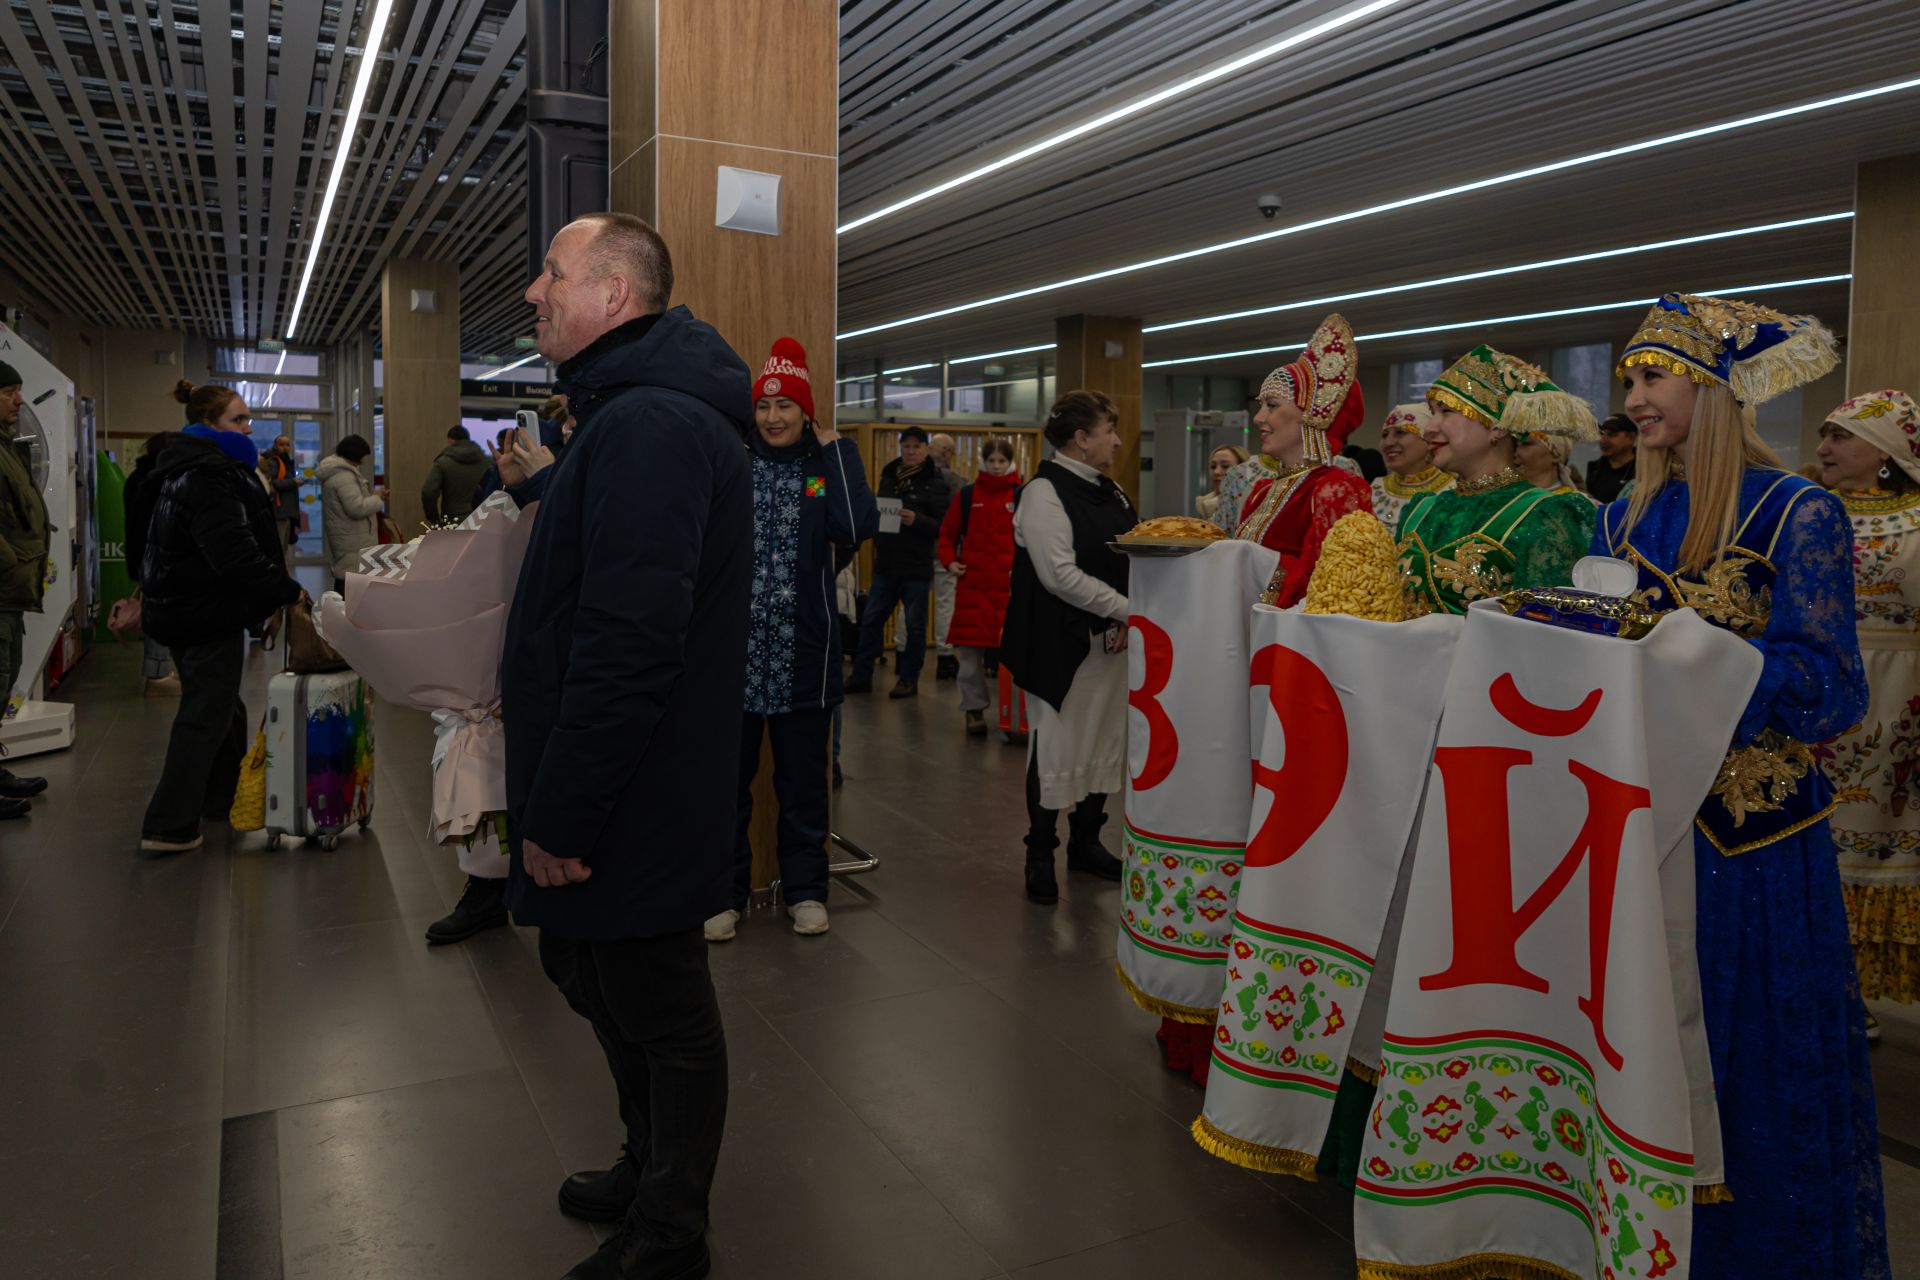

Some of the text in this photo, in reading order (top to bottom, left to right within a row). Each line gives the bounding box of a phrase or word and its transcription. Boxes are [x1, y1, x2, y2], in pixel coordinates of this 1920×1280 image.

[482, 384, 498, 393] Exit
[525, 385, 553, 395] Выход
[1419, 672, 1651, 1072] Й
